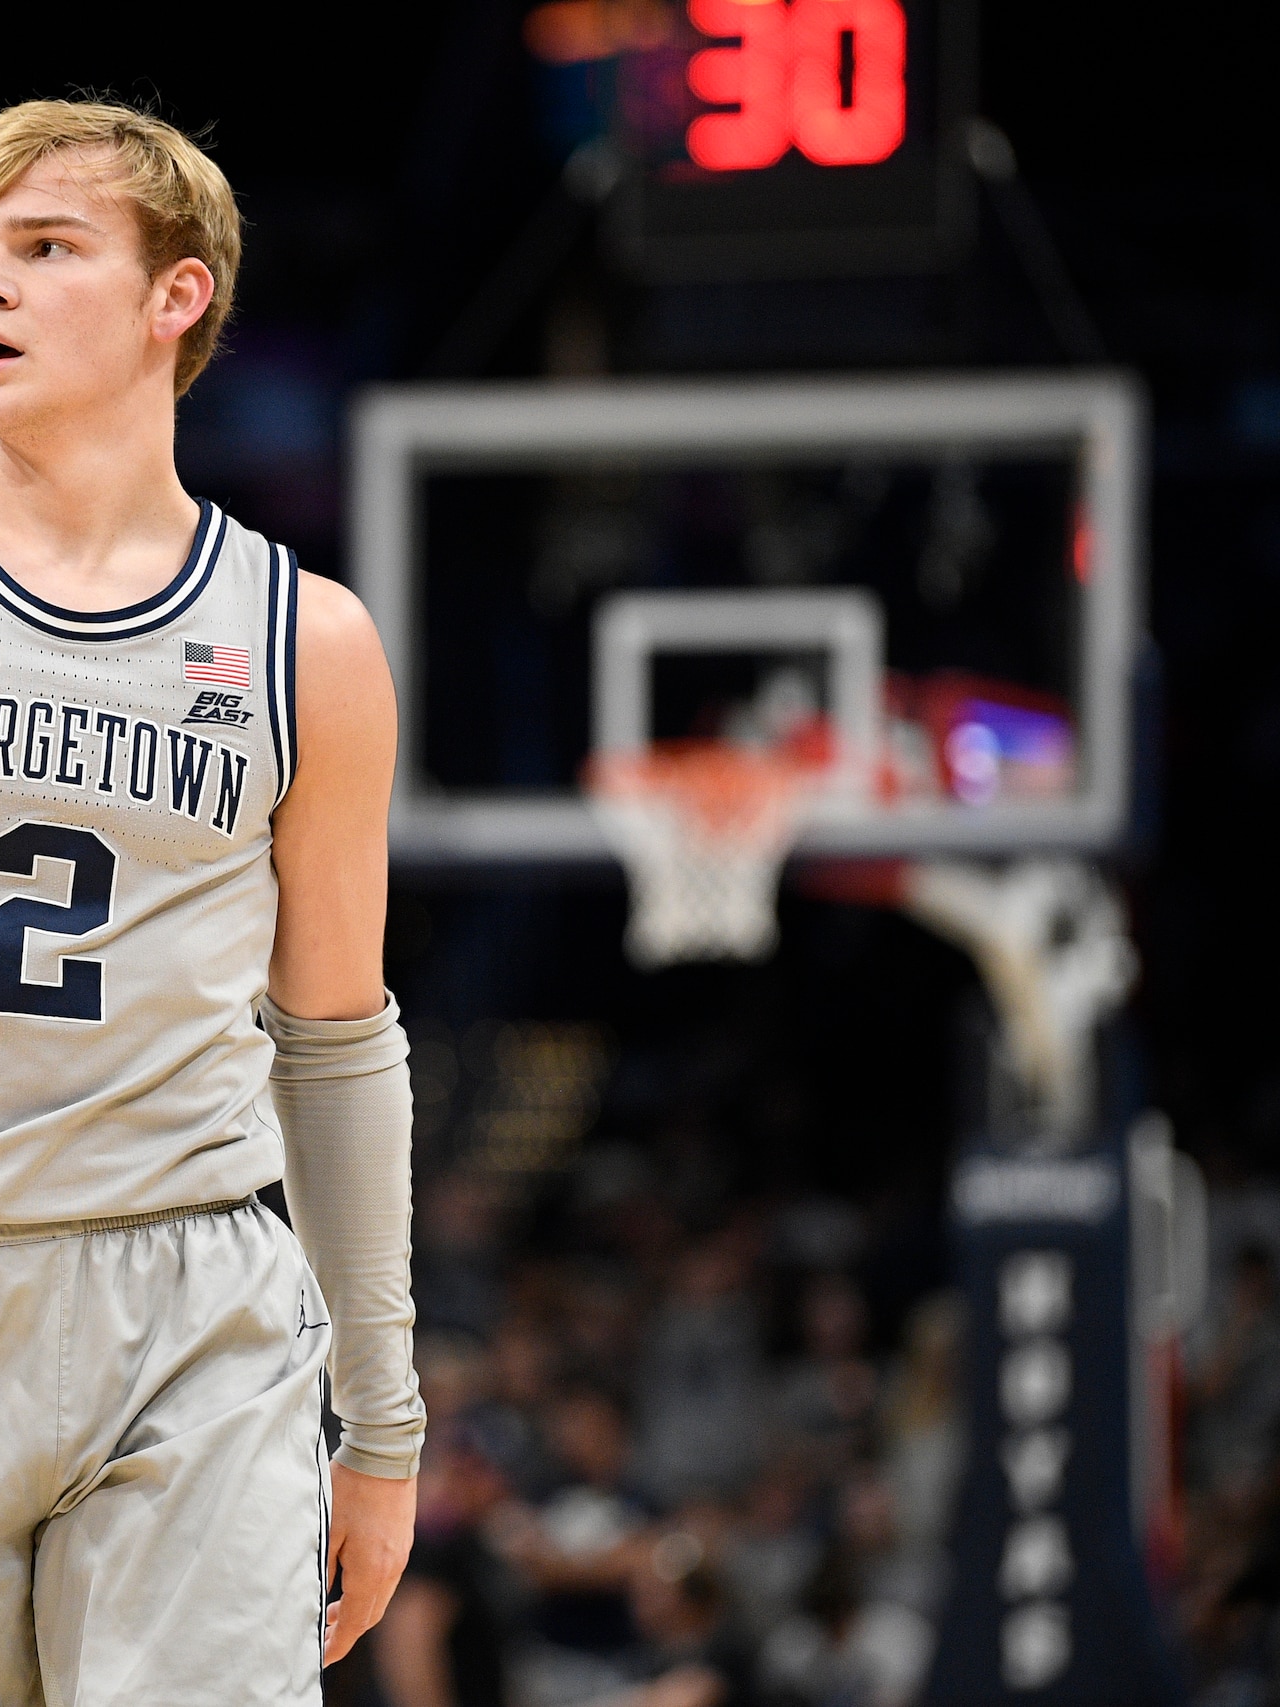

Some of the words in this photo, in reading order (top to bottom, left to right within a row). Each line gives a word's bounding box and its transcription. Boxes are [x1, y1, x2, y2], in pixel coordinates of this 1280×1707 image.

[687, 0, 906, 171] 30
[195, 692, 244, 707] BIG
[188, 705, 254, 724] EAST
